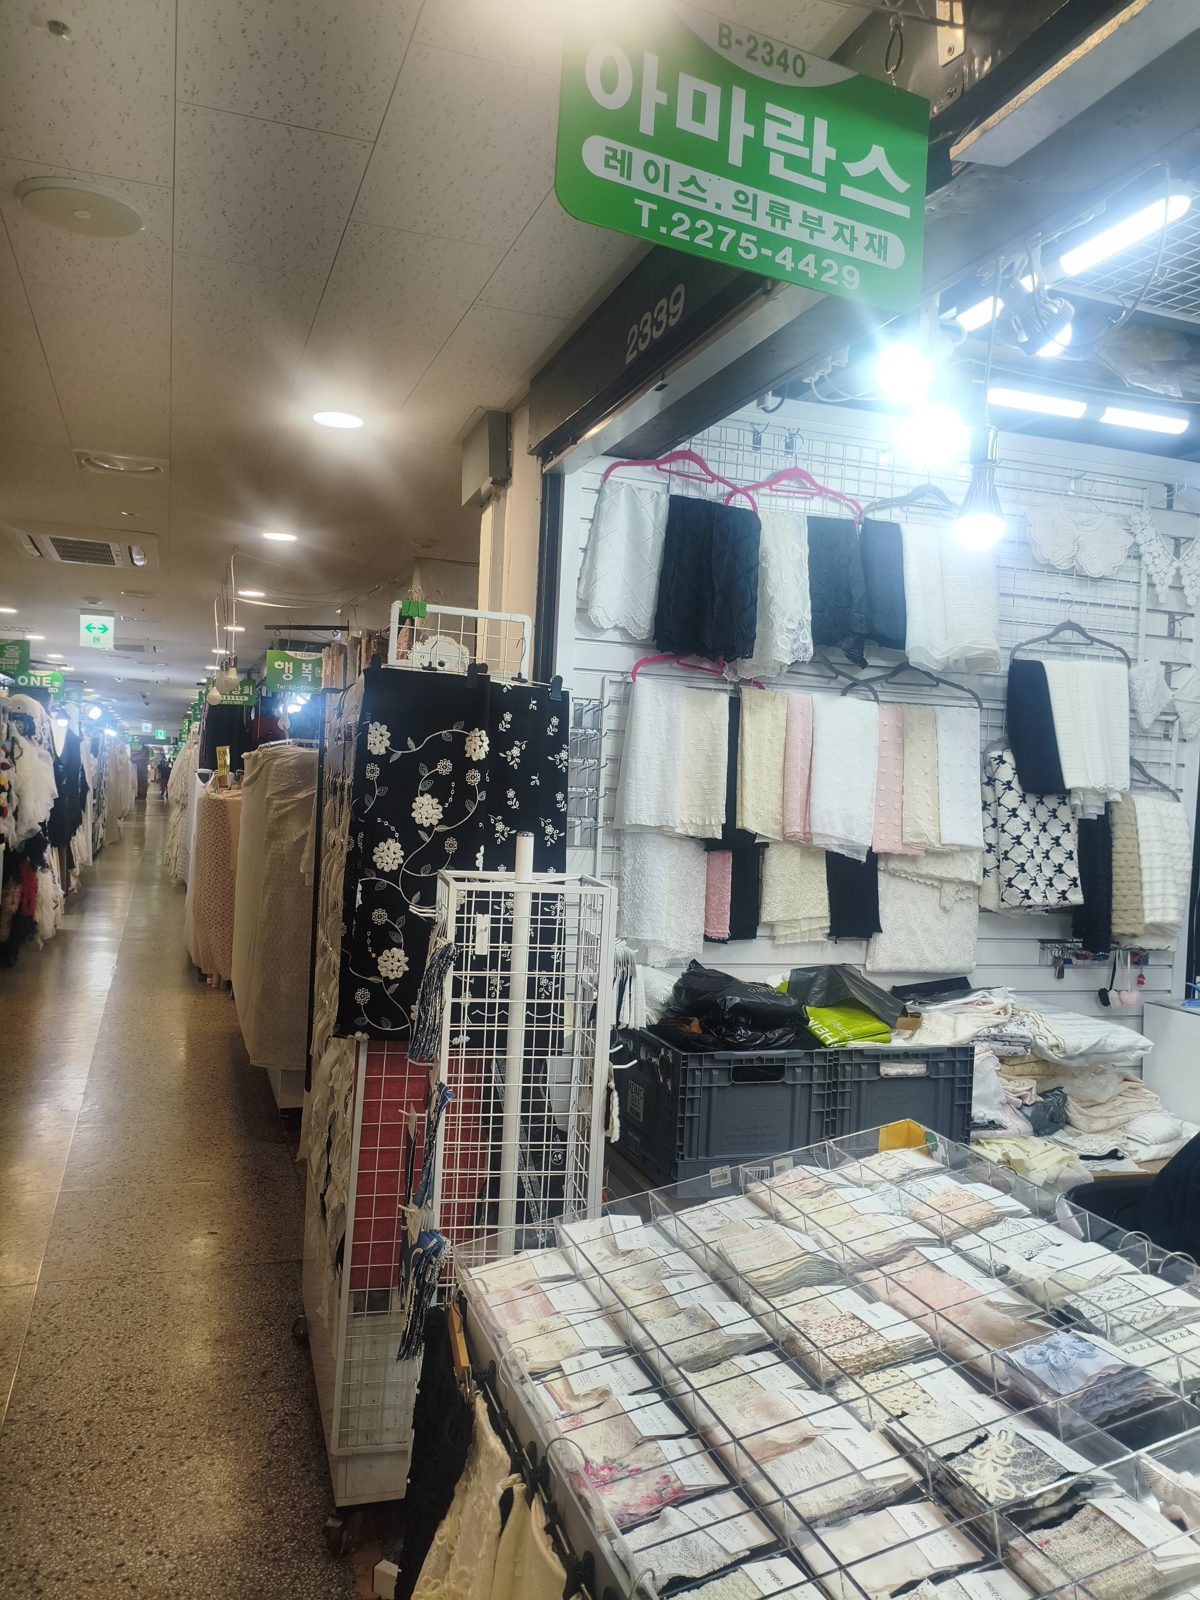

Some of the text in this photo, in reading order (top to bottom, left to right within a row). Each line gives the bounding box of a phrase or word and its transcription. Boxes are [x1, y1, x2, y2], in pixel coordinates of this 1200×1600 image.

[717, 22, 807, 79] B-2340
[585, 38, 911, 219] 아마란스
[603, 144, 889, 263] 레이스.의류부자재
[633, 197, 861, 291] T.2275-4429
[625, 283, 686, 366] 2339
[17, 675, 52, 687] ONE
